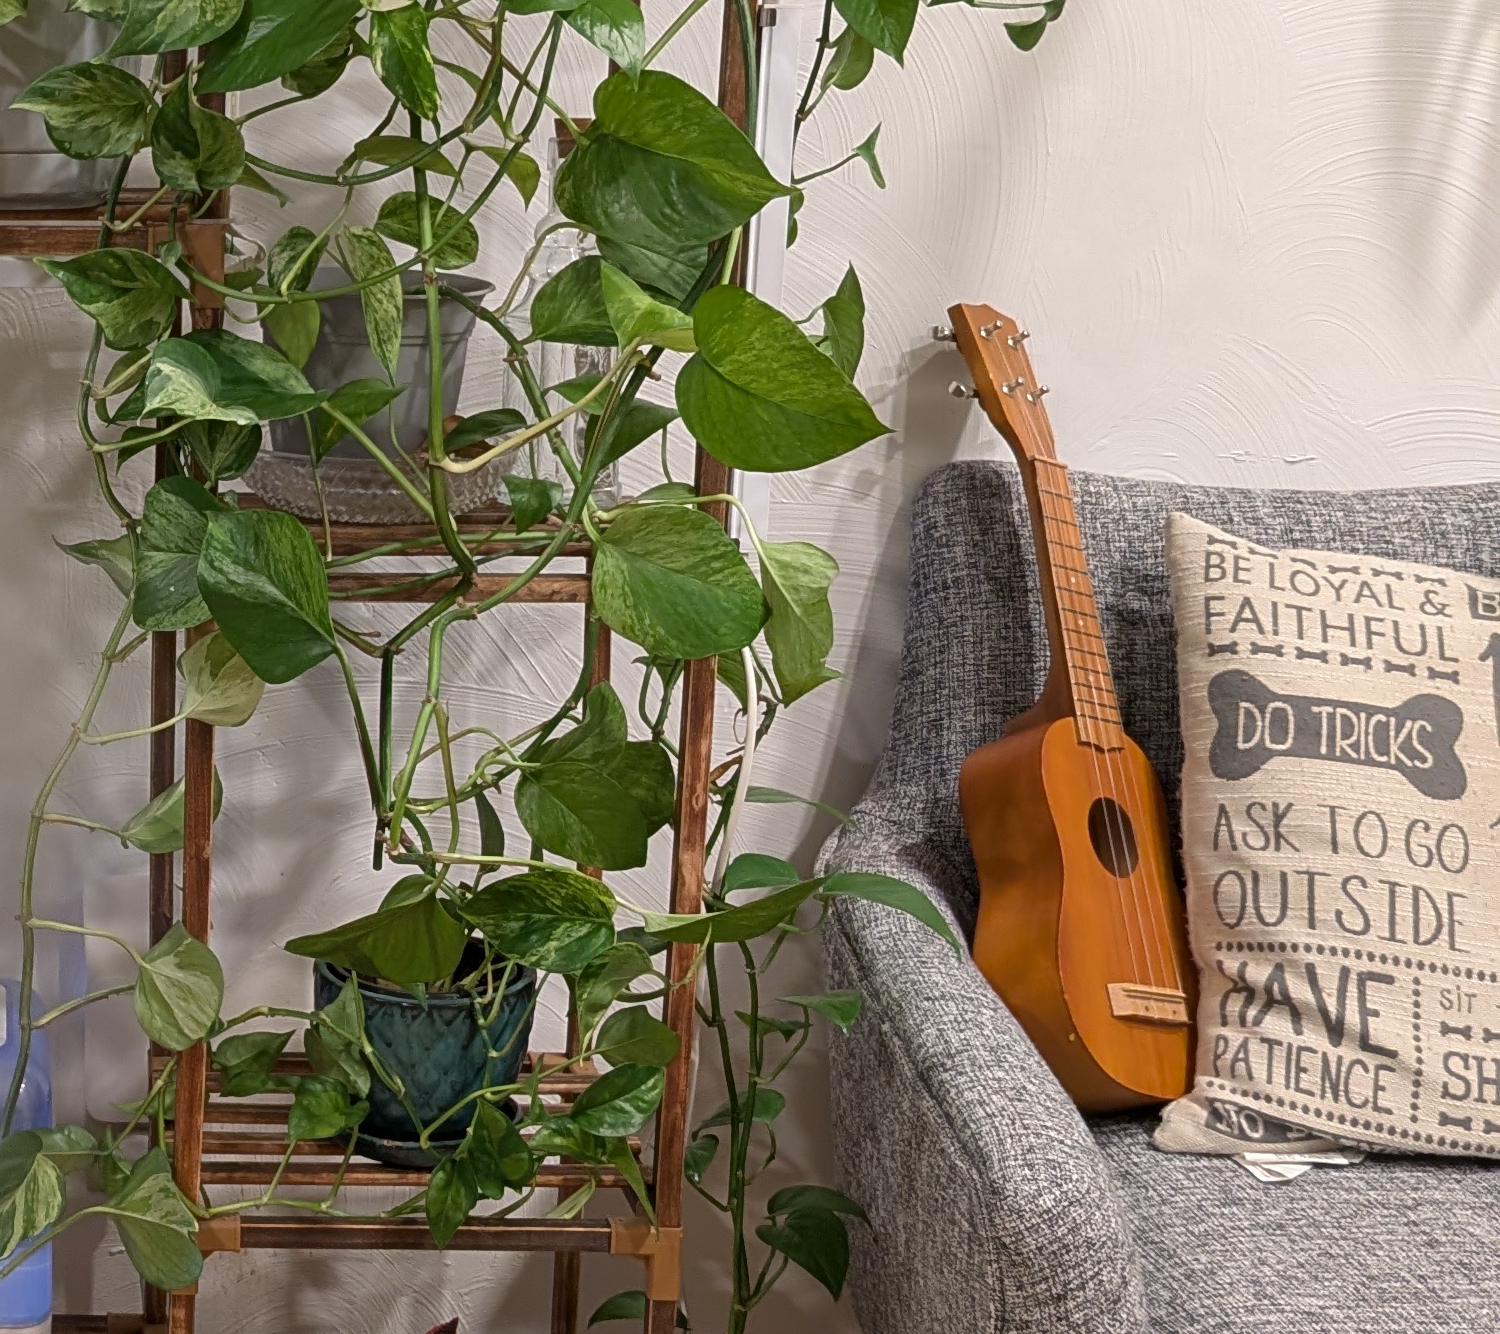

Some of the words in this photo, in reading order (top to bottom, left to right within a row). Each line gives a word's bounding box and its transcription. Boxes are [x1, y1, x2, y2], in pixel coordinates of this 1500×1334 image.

[1204, 551, 1250, 585] BE
[1268, 562, 1405, 612] LOYAL
[1419, 589, 1452, 618] &
[1204, 595, 1460, 663] FAITHFUL
[1237, 701, 1295, 751] DO
[1311, 706, 1434, 769] TRICKS
[1213, 802, 1300, 853] ASK
[1317, 803, 1388, 859] TO
[1404, 819, 1469, 874] GO
[1213, 870, 1471, 954] OUTSIDE
[1215, 959, 1399, 1060] HAVE
[1213, 1034, 1397, 1116] PATIENCE
